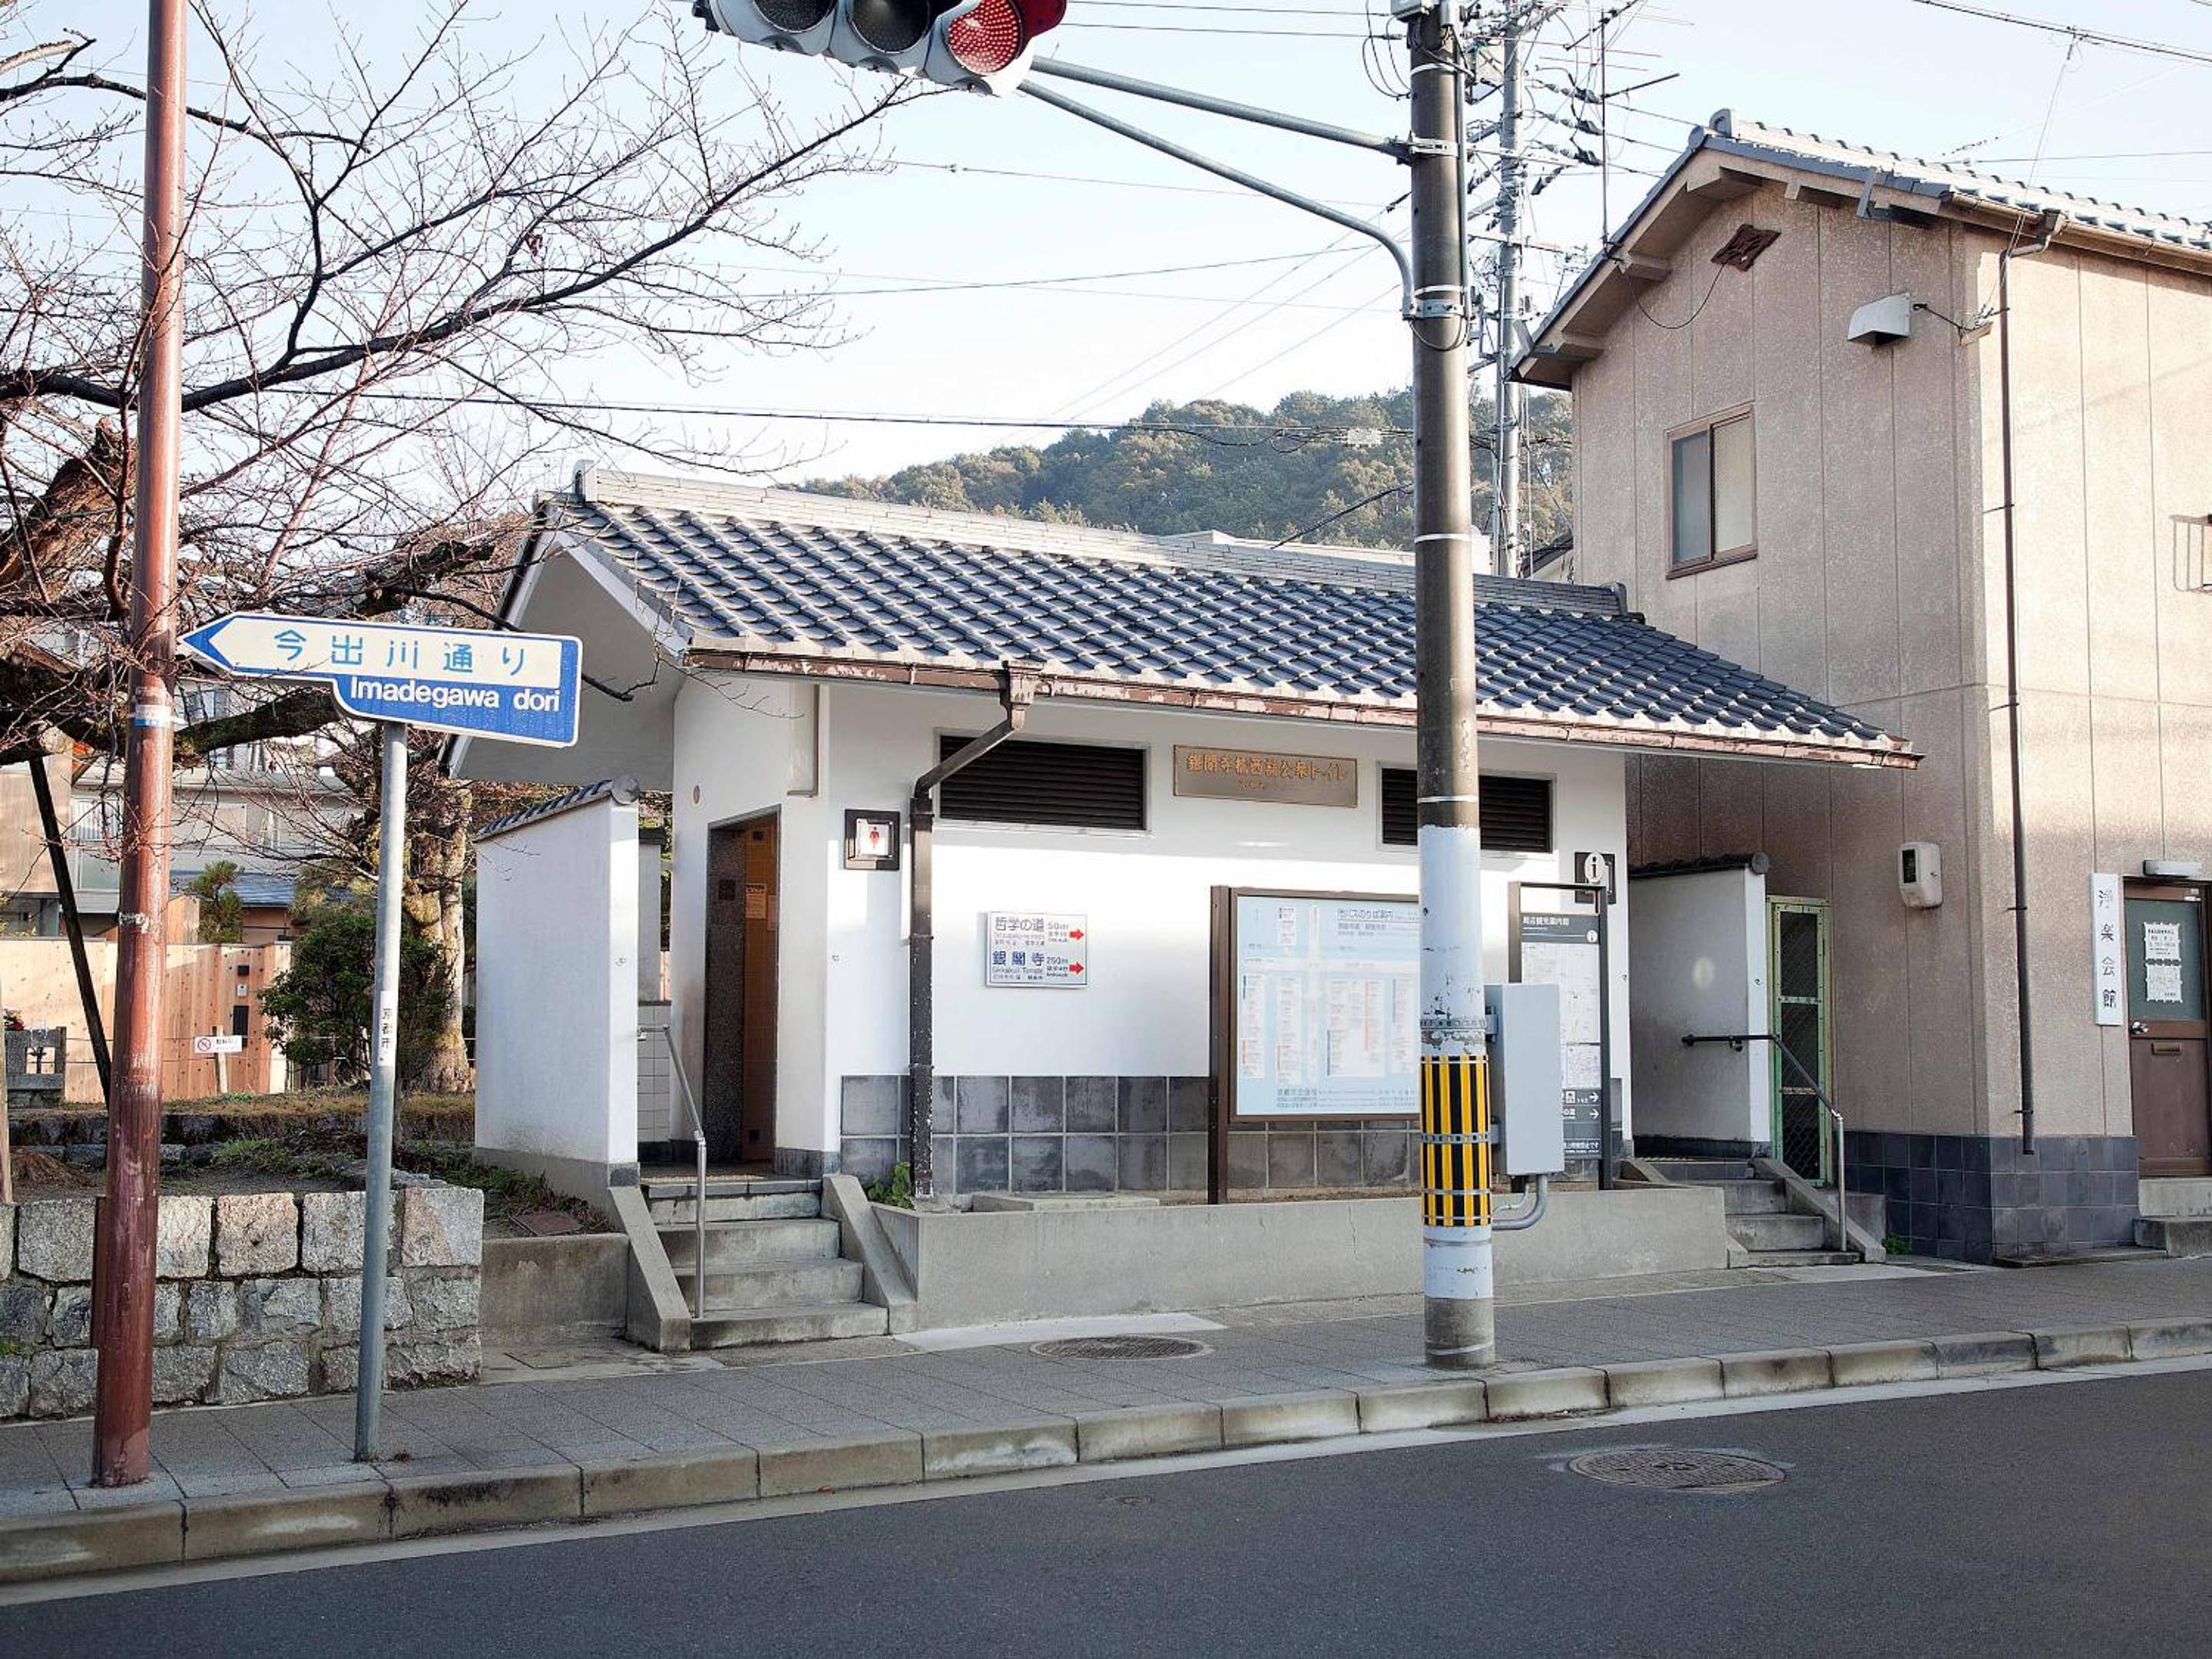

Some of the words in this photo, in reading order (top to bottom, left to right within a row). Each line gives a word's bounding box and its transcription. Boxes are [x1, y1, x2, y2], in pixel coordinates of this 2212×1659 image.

[273, 629, 525, 677] 今出川通り
[350, 676, 499, 709] Imadegawa
[514, 687, 560, 712] dori
